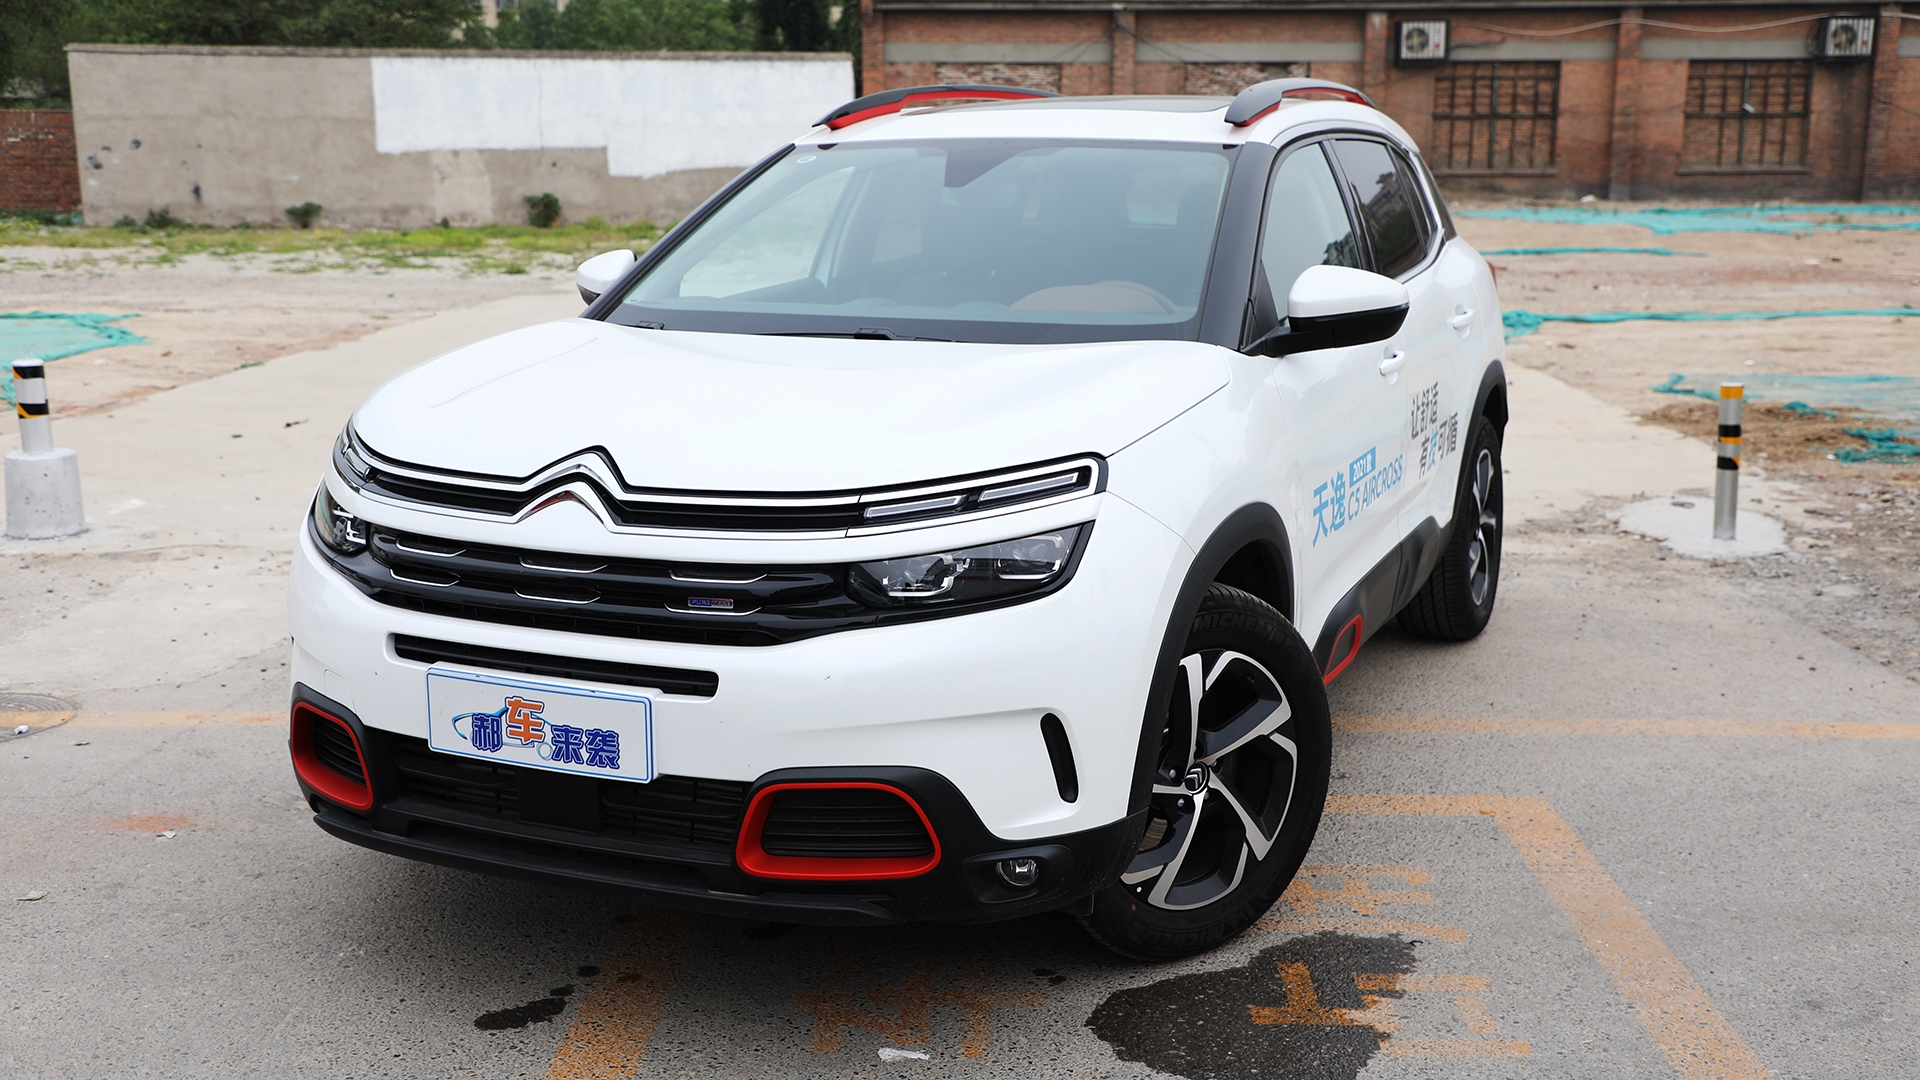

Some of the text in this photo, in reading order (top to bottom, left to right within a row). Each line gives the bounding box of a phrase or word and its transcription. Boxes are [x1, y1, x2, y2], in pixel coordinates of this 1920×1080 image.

[1411, 381, 1438, 440] 让舒适
[1419, 412, 1458, 479] 有技可循
[1313, 471, 1346, 548] 天逸
[1348, 454, 1403, 521] C5 AIRCROSS
[1192, 612, 1286, 646] MICHELIN
[471, 696, 620, 769] 郝车来袭
